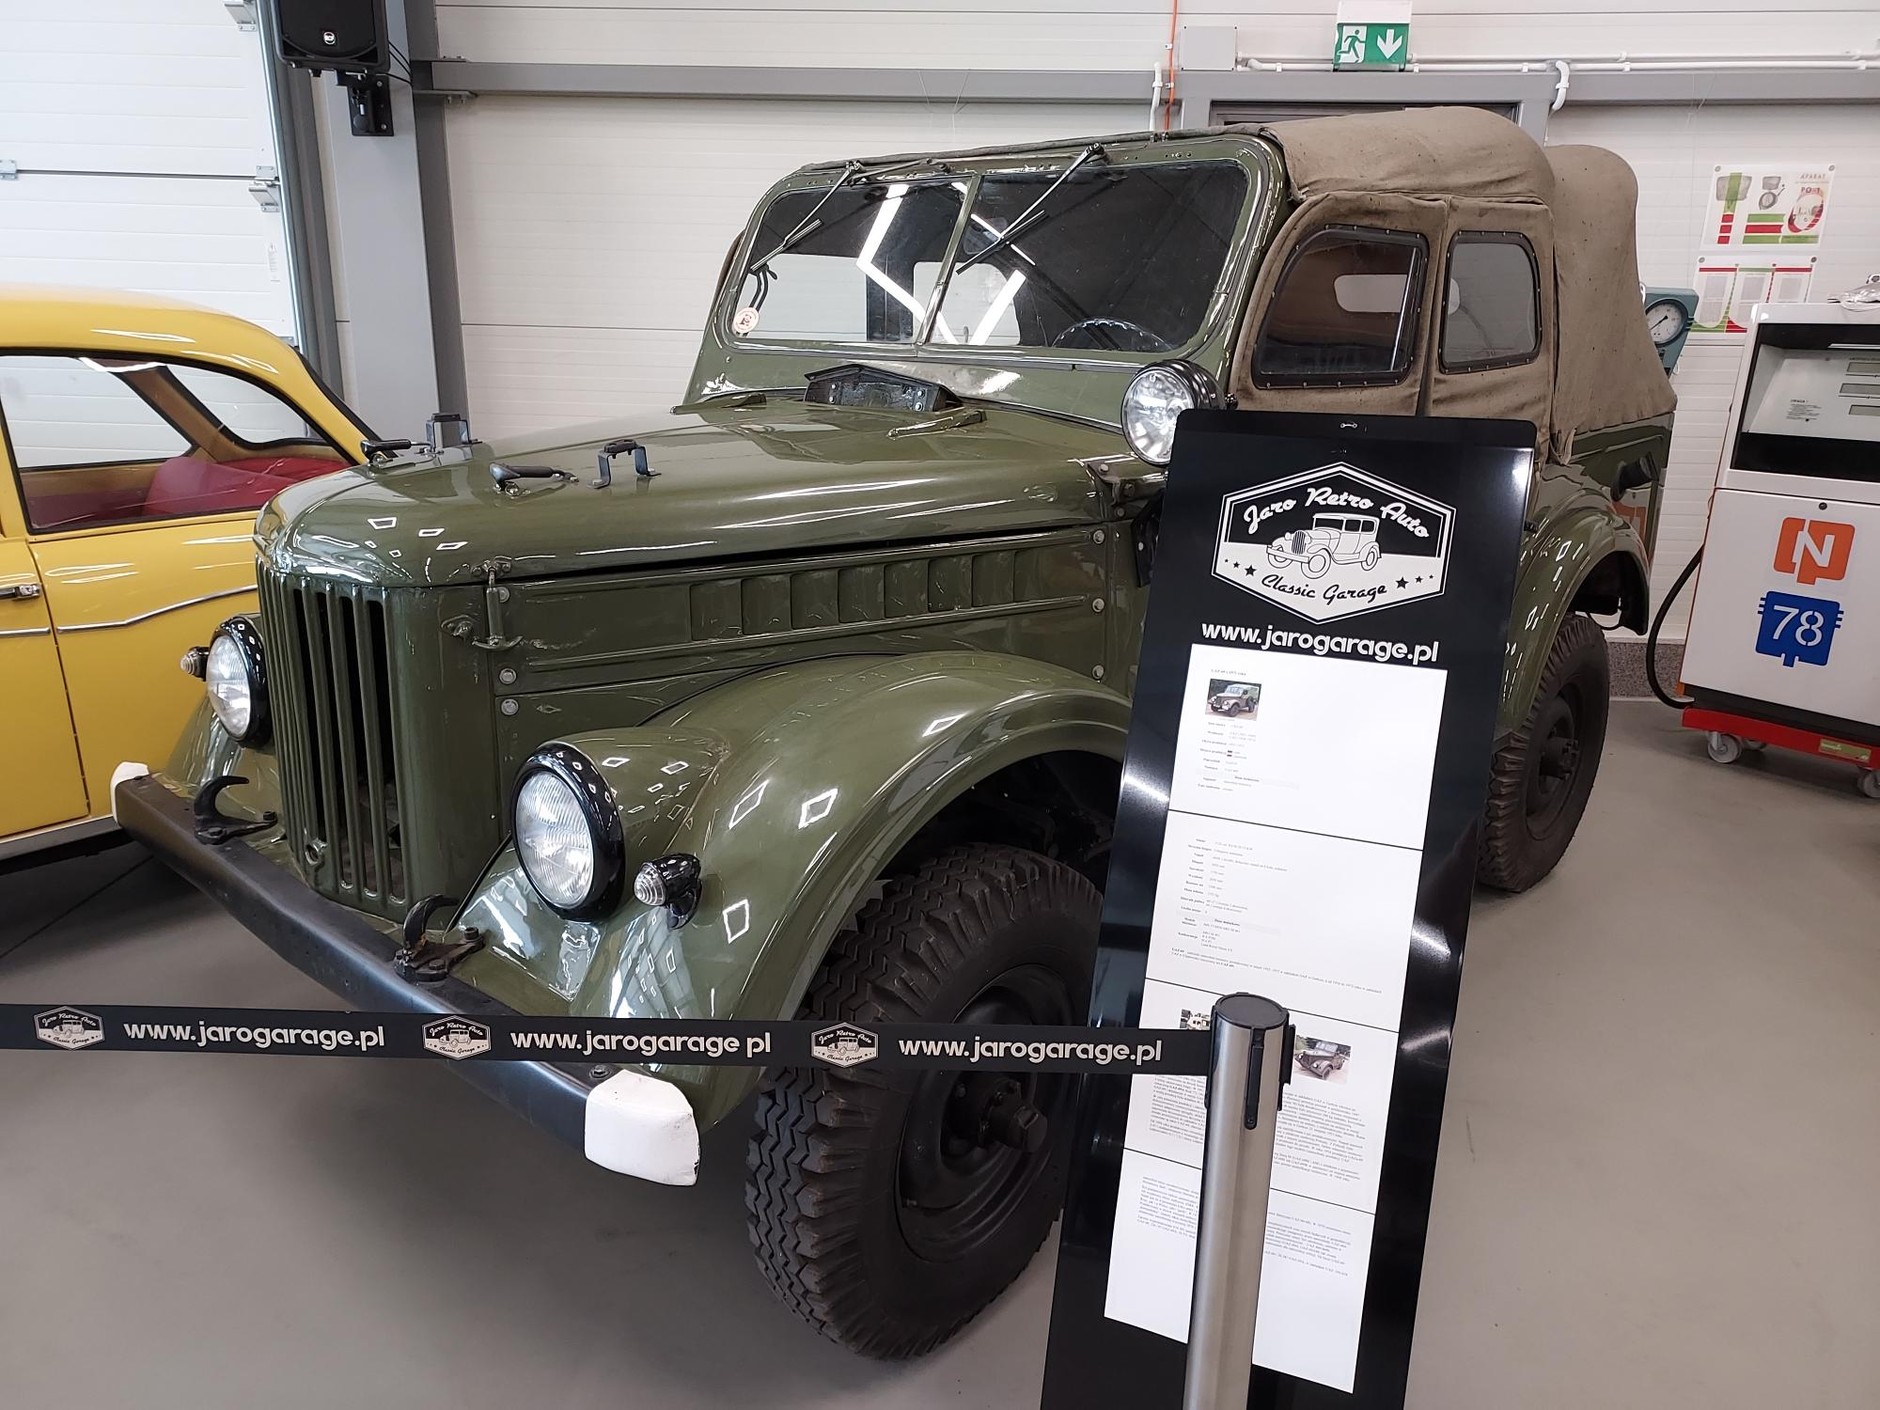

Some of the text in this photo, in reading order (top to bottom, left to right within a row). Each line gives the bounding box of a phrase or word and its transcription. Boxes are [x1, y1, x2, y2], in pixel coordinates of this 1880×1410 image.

[1243, 486, 1429, 539] Jaro Retro Auto
[1260, 573, 1387, 606] Classic Garage
[1201, 622, 1440, 665] www.jarogarage.pl
[1772, 605, 1824, 647] 78
[123, 1020, 386, 1052] www.jarogarage.pl
[897, 1035, 1163, 1066] www.jarogarage.pl
